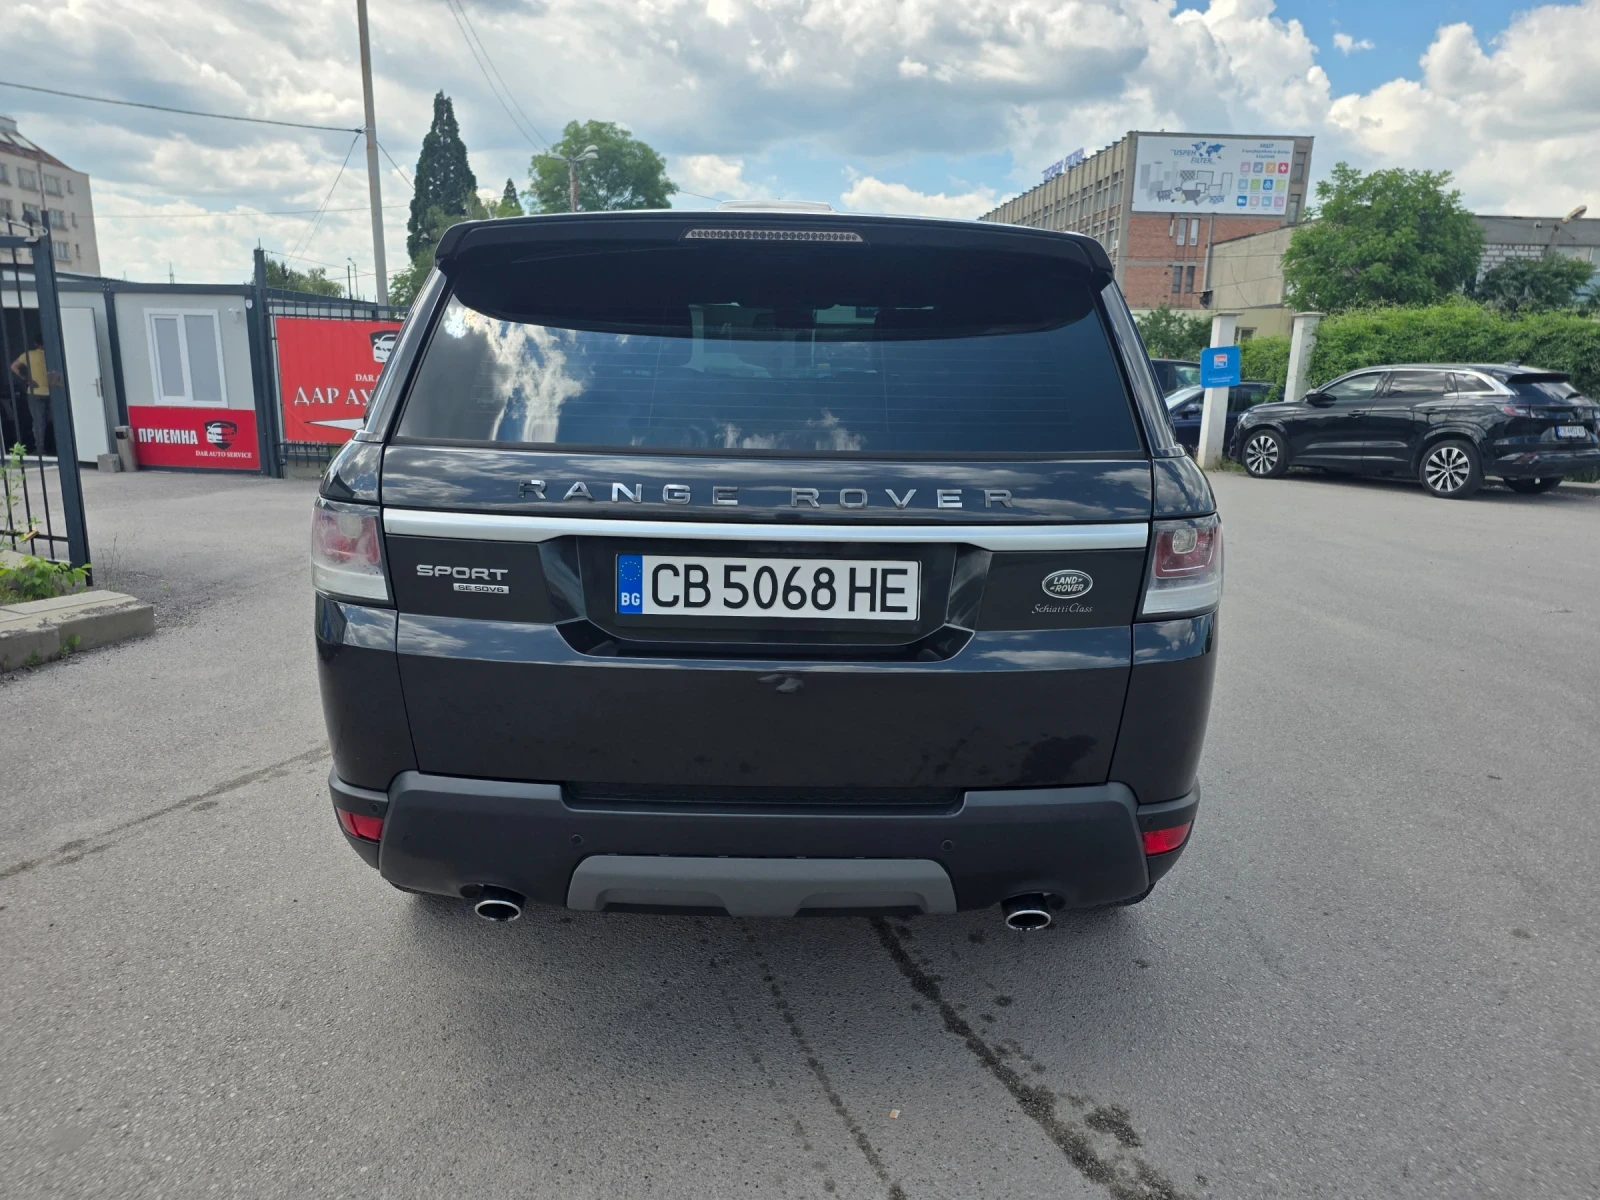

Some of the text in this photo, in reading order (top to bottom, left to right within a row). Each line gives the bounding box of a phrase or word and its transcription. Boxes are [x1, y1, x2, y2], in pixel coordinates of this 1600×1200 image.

[1173, 149, 1197, 157] USPEH
[355, 373, 375, 382] DAR
[294, 386, 339, 407] ДАР
[138, 428, 198, 445] ПРИЕМНА
[518, 479, 1013, 508] RANGE ROVER
[416, 564, 509, 581] SPORT
[1053, 576, 1078, 585] LAND
[474, 585, 504, 593] SDV6
[651, 563, 908, 613] CB 5068 HE
[1054, 584, 1084, 592] ROVER
[621, 592, 641, 606] BG
